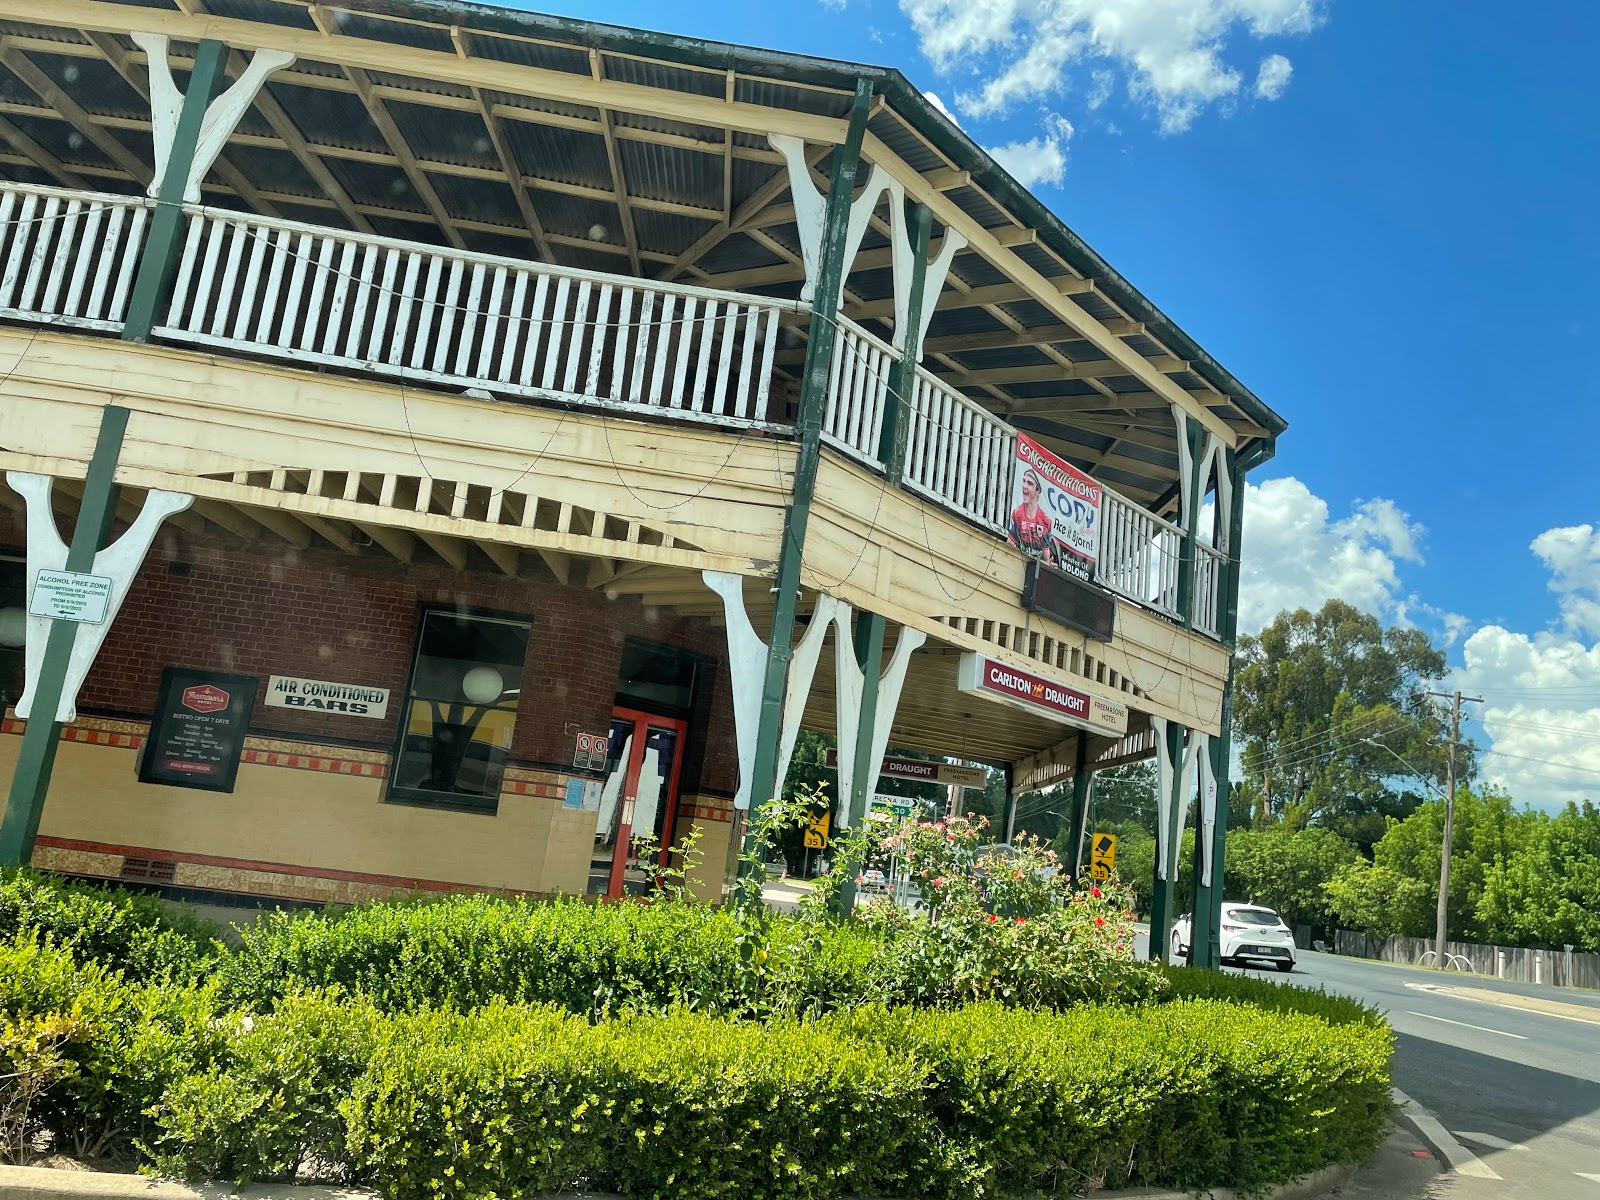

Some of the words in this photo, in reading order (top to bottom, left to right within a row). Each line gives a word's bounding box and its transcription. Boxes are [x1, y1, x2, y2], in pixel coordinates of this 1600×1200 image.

[1019, 442, 1098, 501] CONGRATULATIONS
[1047, 487, 1095, 528] CODY
[37, 583, 74, 593] CONSUMPTION
[39, 575, 70, 585] ALCOHOL
[71, 579, 89, 588] FREE
[89, 582, 109, 590] ZONE
[55, 590, 86, 599] PROHIBITED
[274, 679, 298, 693] AIR
[302, 682, 385, 704] CONDITIONED
[990, 668, 1031, 694] CARLTON
[1045, 687, 1085, 712] DRAUGHT
[284, 695, 369, 714] BARS
[1094, 701, 1125, 718] FREEMASONS
[1101, 713, 1116, 724] HOTEL
[889, 762, 933, 775] DRAUGHT
[943, 767, 980, 777] FREEMASONS
[952, 773, 969, 782] HOTEL
[894, 807, 905, 815] 30
[806, 837, 818, 846] 35
[1094, 870, 1105, 878] 35
